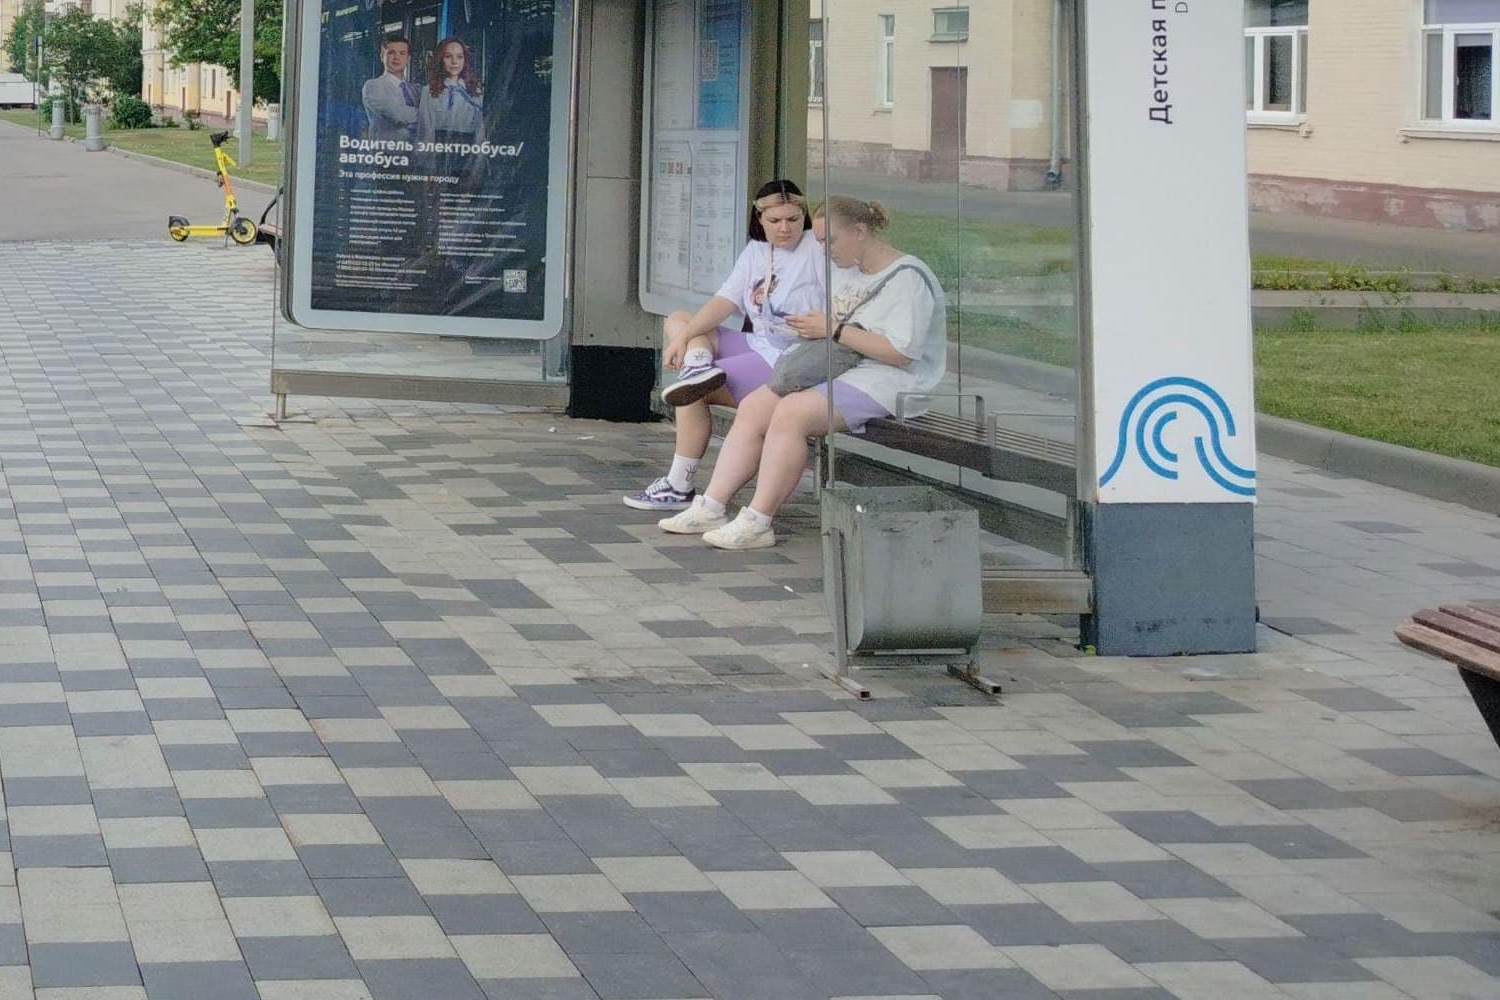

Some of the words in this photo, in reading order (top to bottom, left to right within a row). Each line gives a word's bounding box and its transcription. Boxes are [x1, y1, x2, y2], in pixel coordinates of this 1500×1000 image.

[1149, 19, 1173, 125] Детская
[339, 135, 414, 152] Водитель
[416, 140, 525, 159] электробуса/
[339, 152, 410, 169] автобуса
[338, 169, 353, 179] Эта
[354, 171, 401, 182] профессия
[402, 174, 429, 183] нужна
[430, 176, 460, 185] городу
